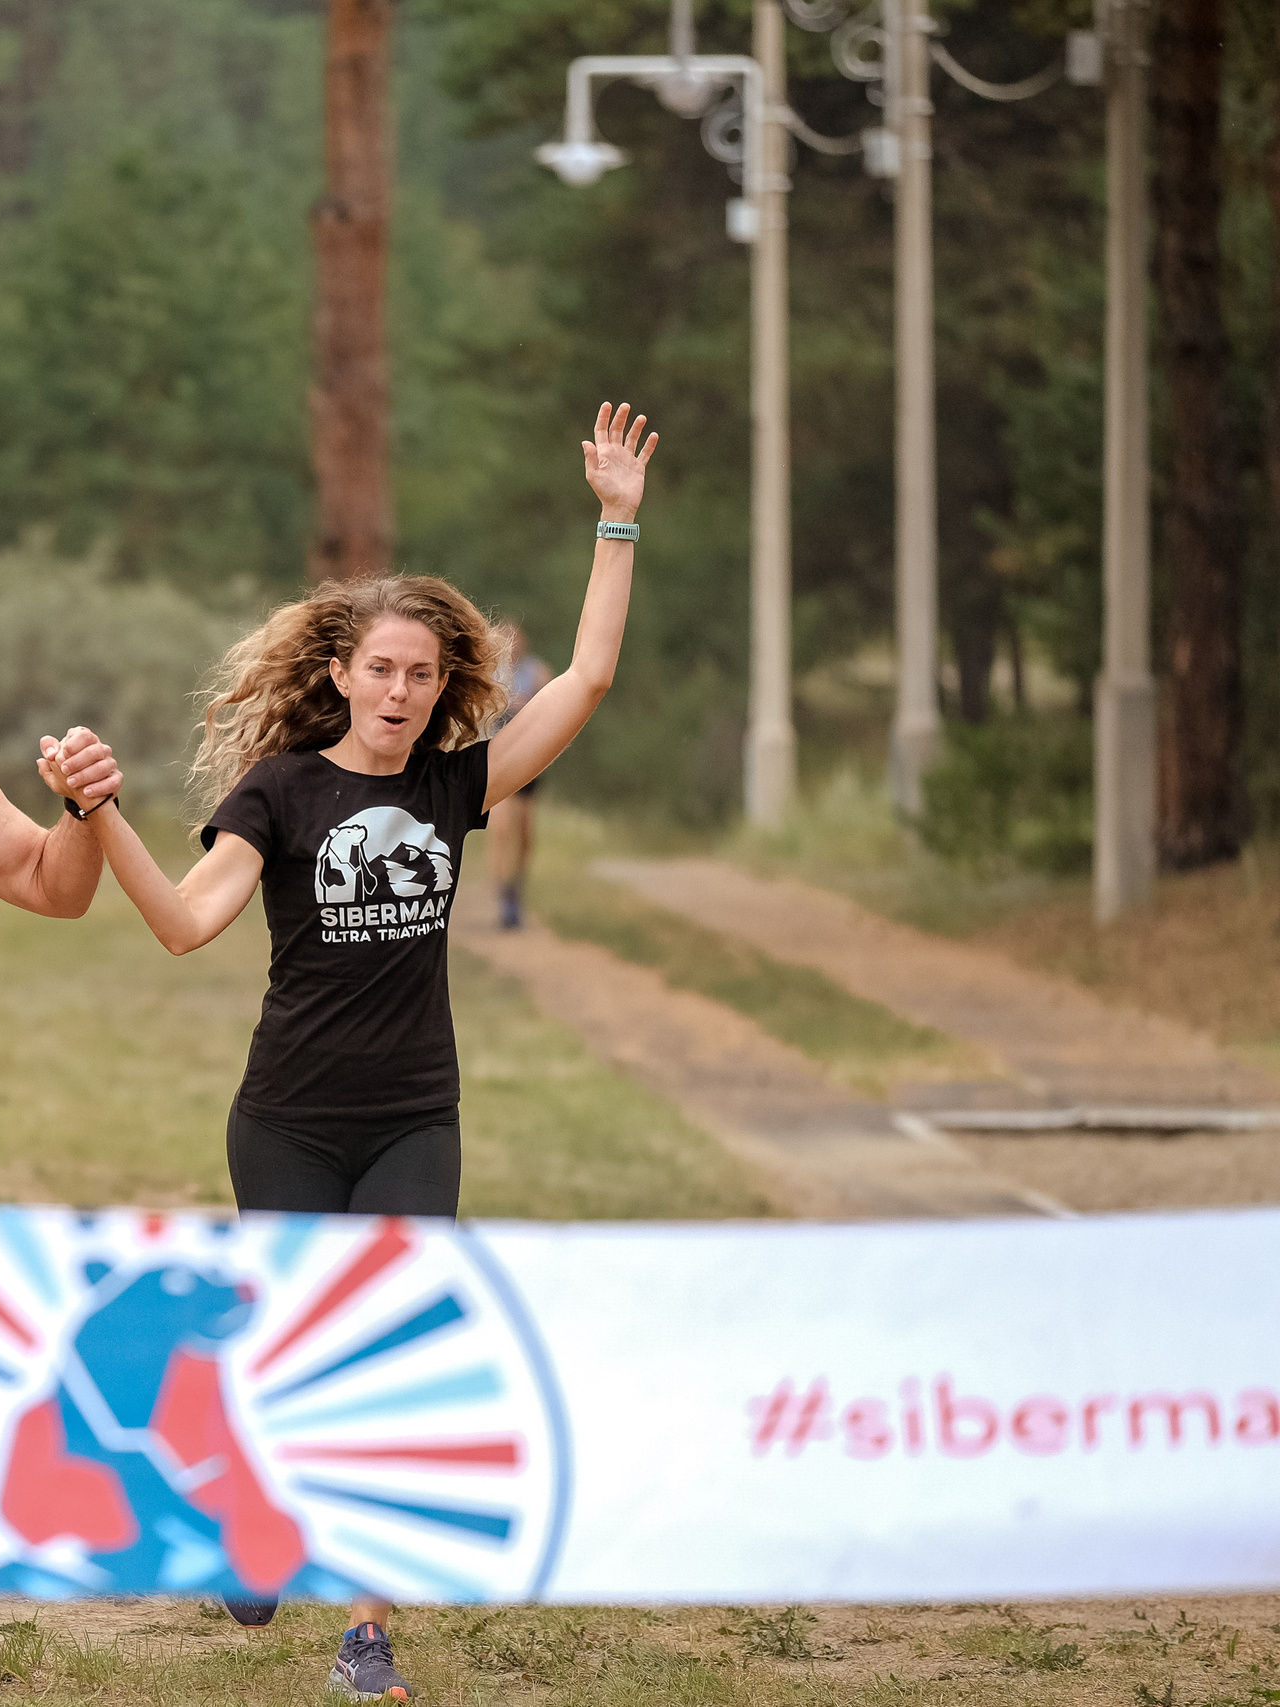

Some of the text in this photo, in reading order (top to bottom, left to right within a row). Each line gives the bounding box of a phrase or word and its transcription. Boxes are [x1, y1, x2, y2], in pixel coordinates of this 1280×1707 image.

[320, 894, 448, 927] SIBERMAN
[321, 930, 371, 943] ULTRA
[746, 1373, 1280, 1459] #siberma
